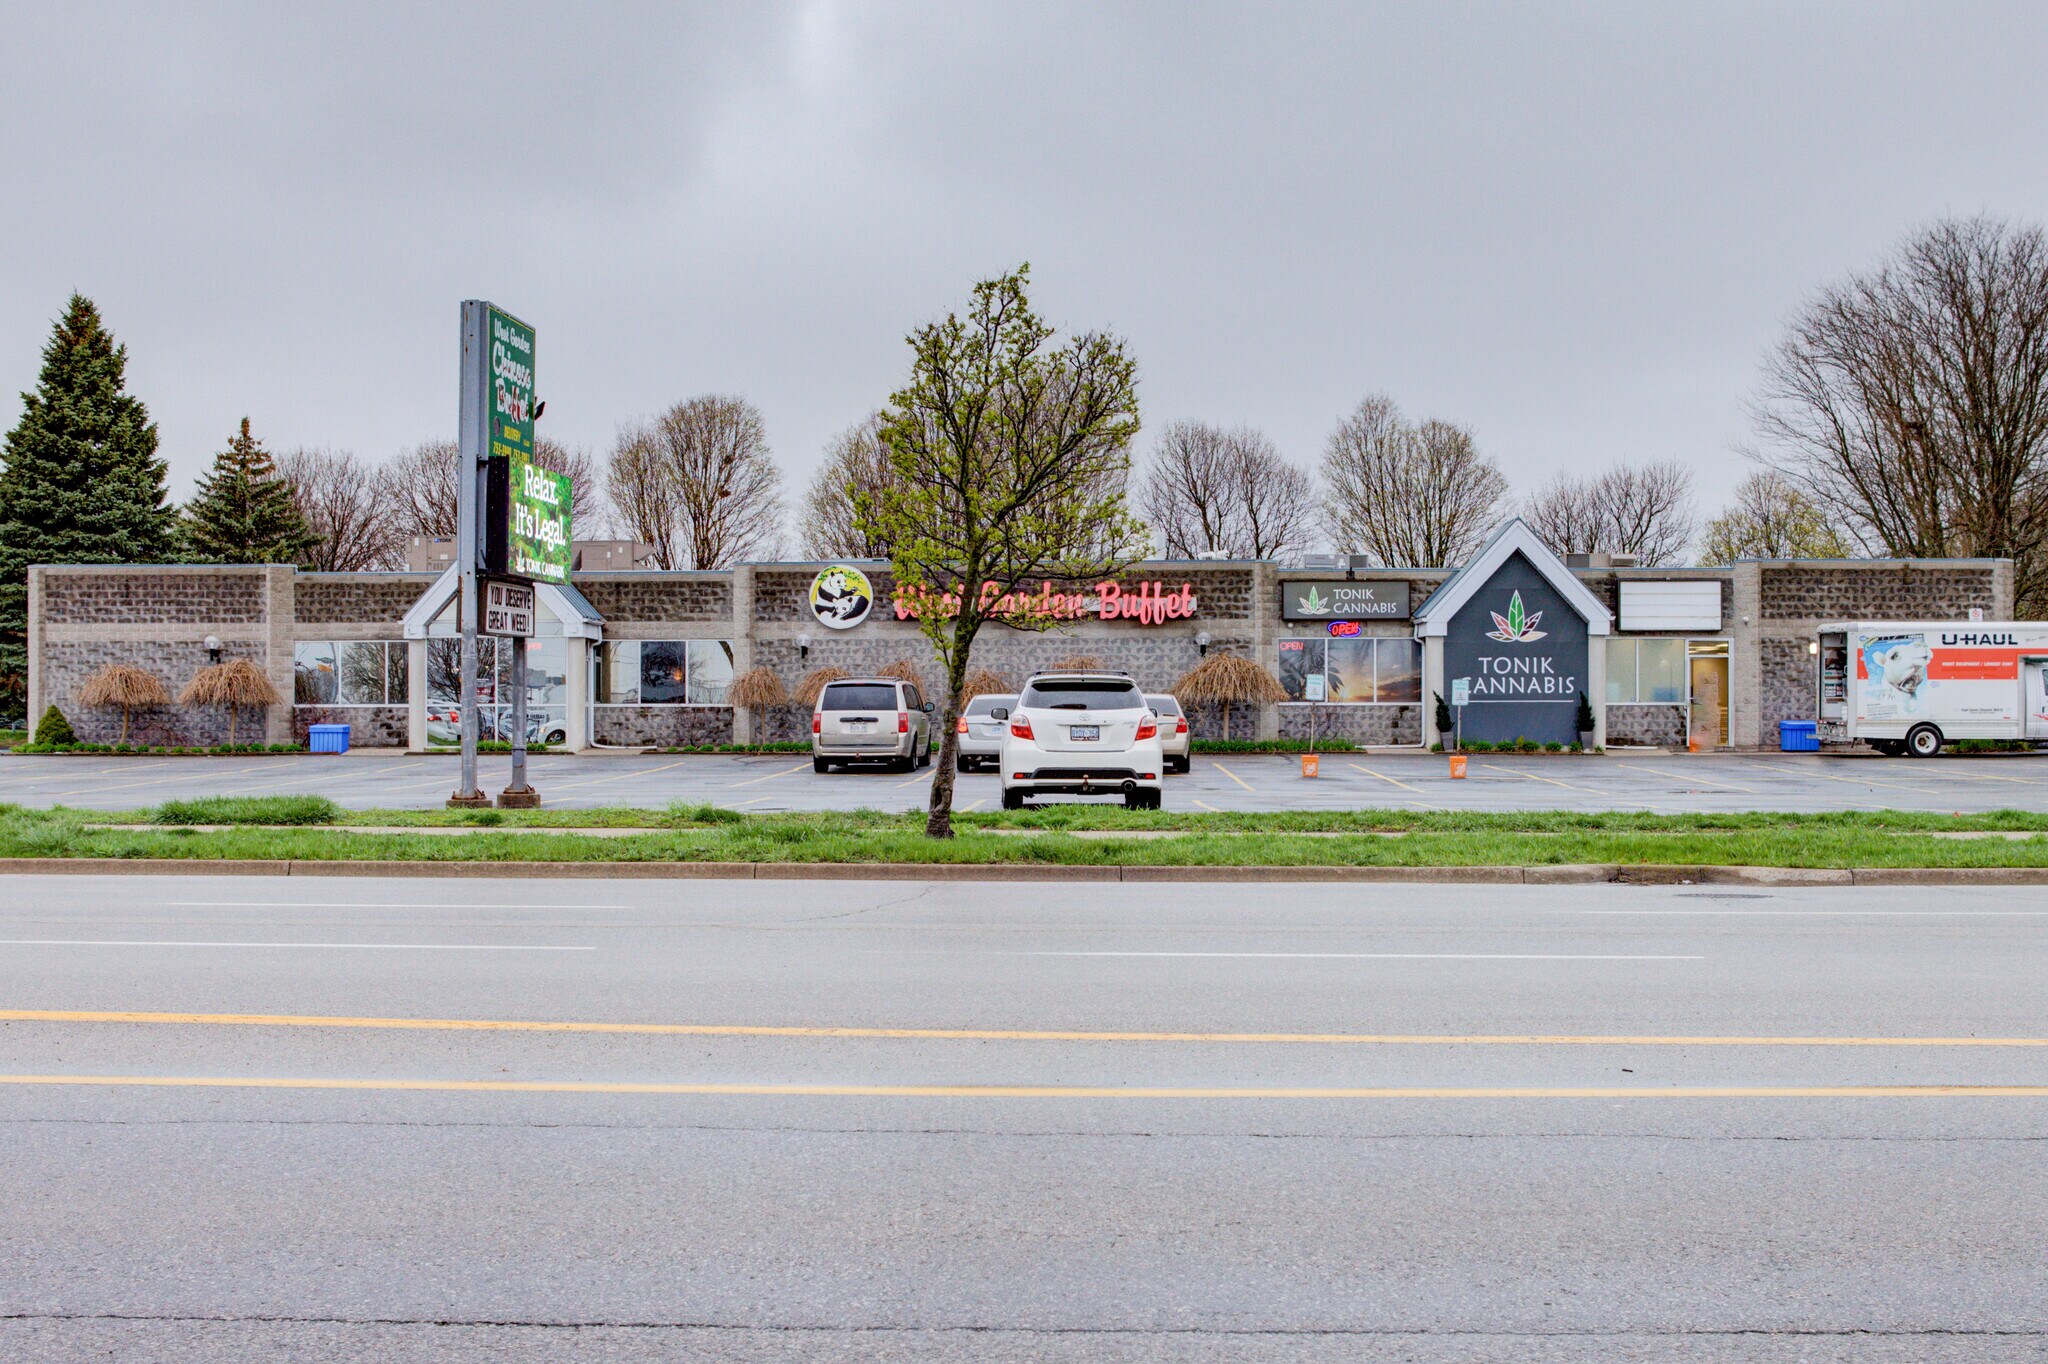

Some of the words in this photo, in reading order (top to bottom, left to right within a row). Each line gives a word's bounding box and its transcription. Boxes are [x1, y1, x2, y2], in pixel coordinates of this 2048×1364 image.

[492, 340, 532, 390] Chinese
[495, 377, 530, 424] Buffet
[524, 464, 559, 505] Relax.
[515, 502, 534, 538] It's
[534, 508, 566, 552] Legal.
[526, 557, 541, 574] TONIK
[490, 585, 503, 606] YOU
[505, 587, 531, 609] DESERVE
[1095, 580, 1196, 625] Buffet
[1333, 588, 1375, 600] TONIK
[1333, 602, 1397, 614] CANNABIS
[488, 610, 508, 630] GREAT
[511, 613, 530, 633] WEED!
[1331, 622, 1359, 637] OPEN
[1280, 641, 1304, 651] OPEN
[1942, 633, 2019, 646] U-HAUL
[1477, 656, 1555, 674] TONIK
